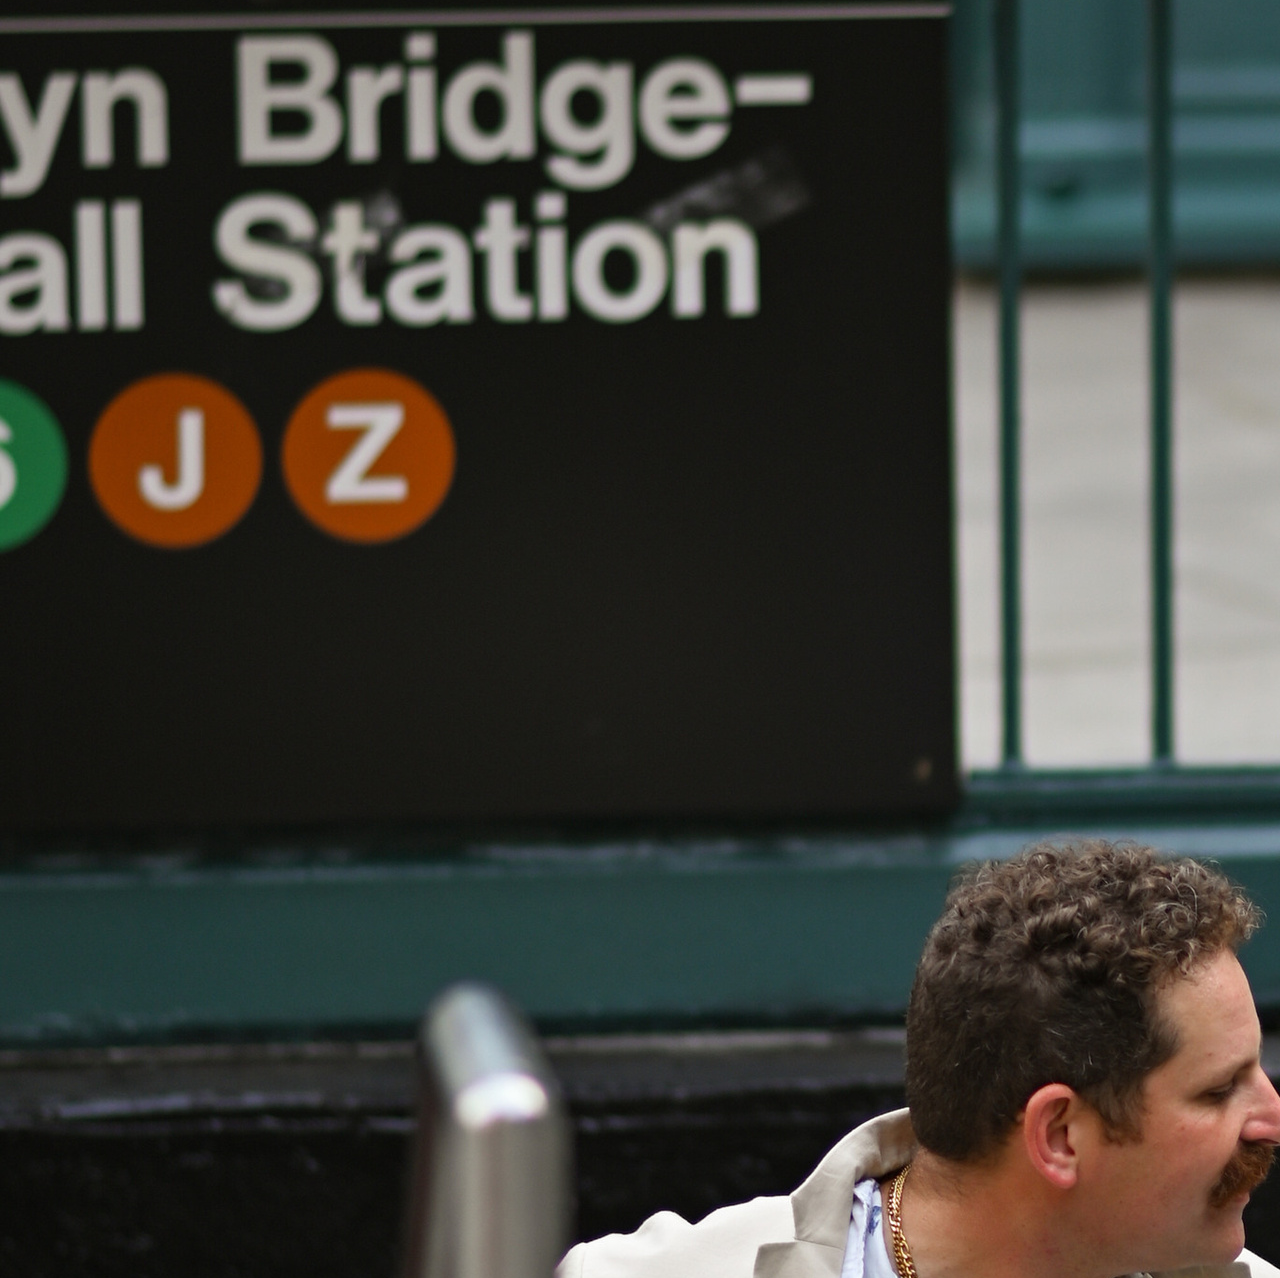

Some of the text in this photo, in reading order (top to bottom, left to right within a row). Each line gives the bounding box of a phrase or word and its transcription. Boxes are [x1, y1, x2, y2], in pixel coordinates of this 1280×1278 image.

[0, 30, 812, 198] yn Bridge-
[0, 192, 760, 334] all Station
[139, 408, 205, 511] J
[325, 402, 408, 503] Z
